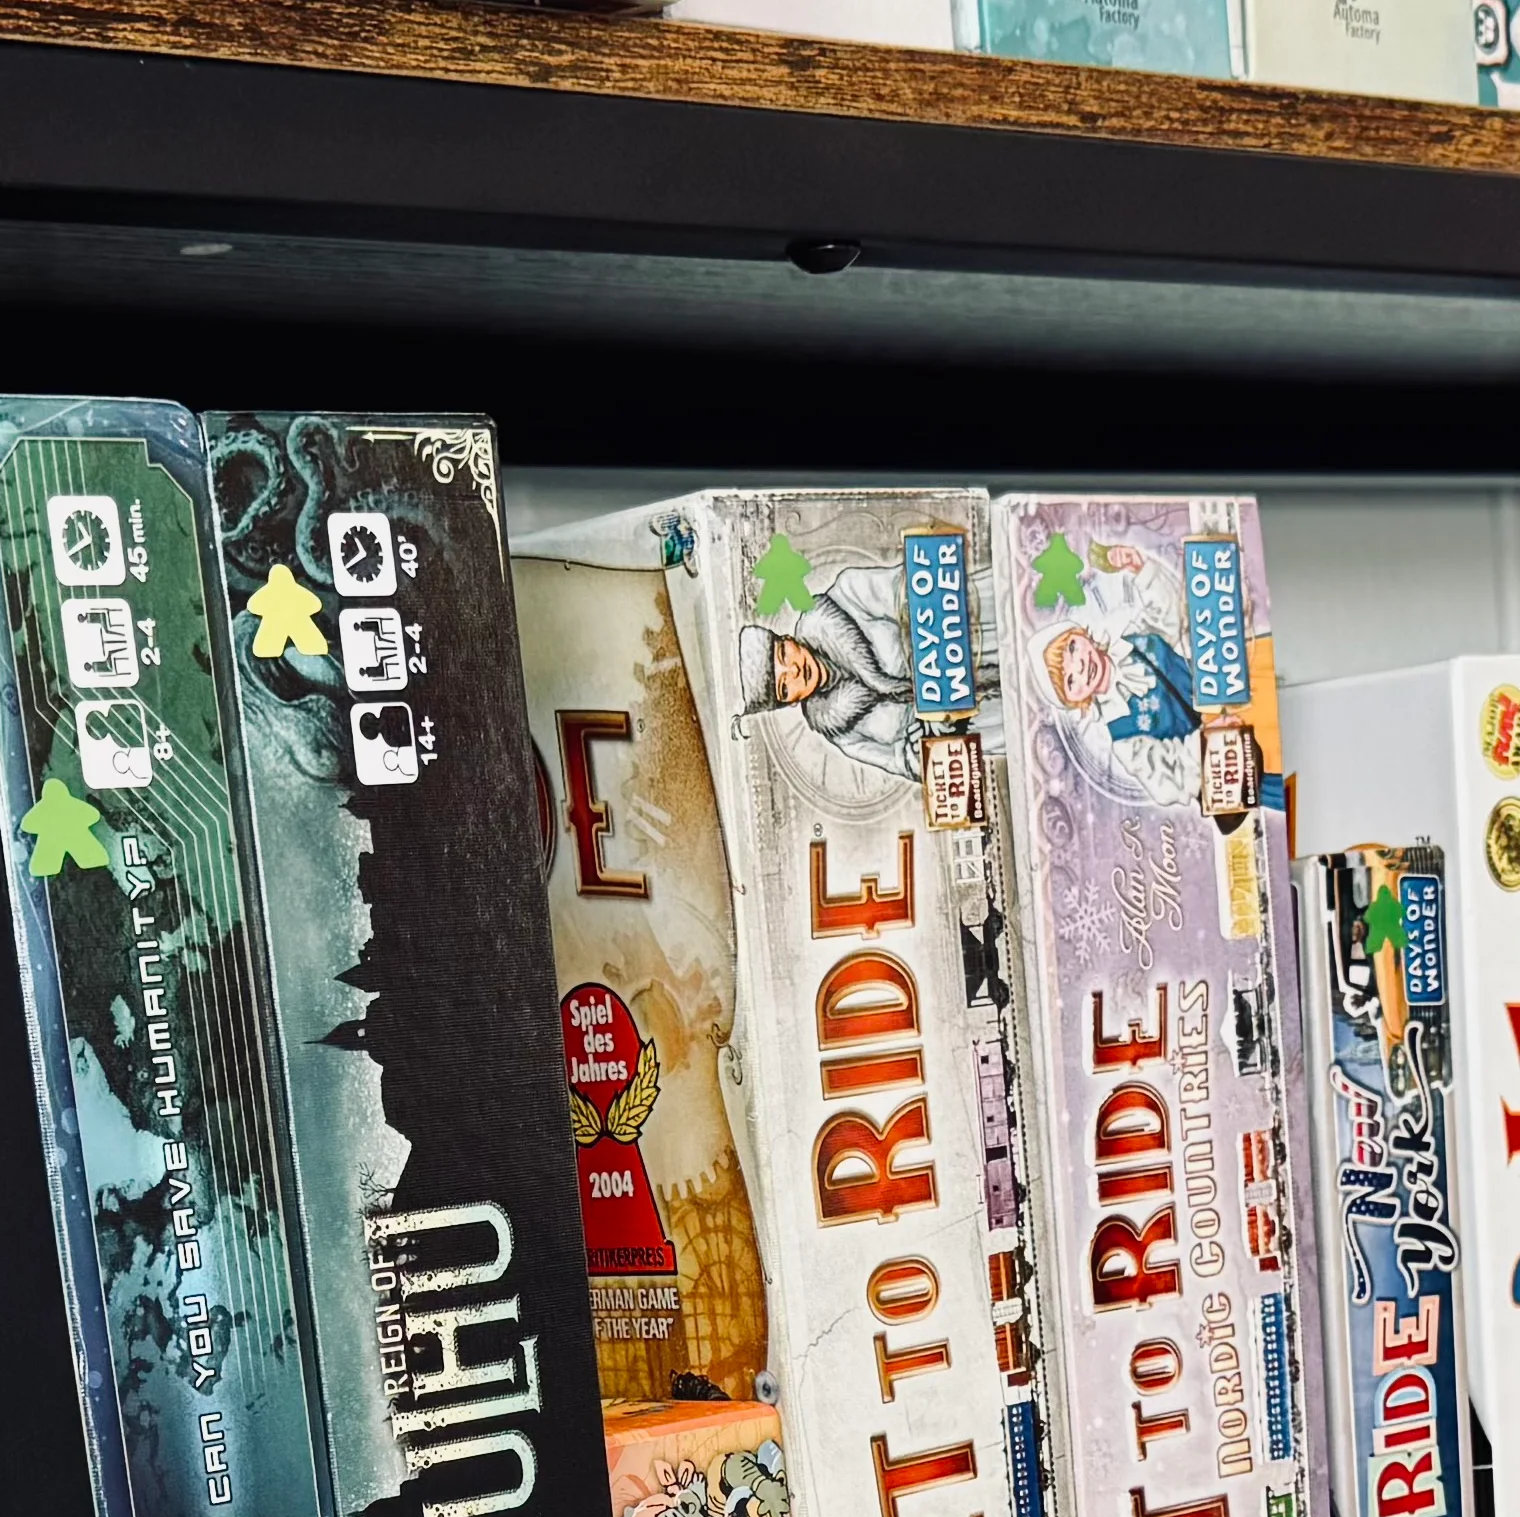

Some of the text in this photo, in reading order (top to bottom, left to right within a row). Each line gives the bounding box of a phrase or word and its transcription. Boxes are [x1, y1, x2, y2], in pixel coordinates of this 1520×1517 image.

[1099, 8, 1140, 31] Factory
[1334, 7, 1380, 25] Automa
[127, 548, 149, 583] 45
[140, 618, 162, 665] 2-4
[409, 623, 428, 674] 2-4
[911, 545, 941, 702] DAYS OF
[938, 544, 970, 701] WONDER
[1191, 550, 1218, 696] DAYS OF
[1214, 550, 1246, 696] WONDER
[154, 726, 174, 760] 8+
[420, 716, 439, 764] 14+
[949, 743, 965, 798] RIDE
[1150, 823, 1184, 931] Moon
[1406, 889, 1423, 993] DAYS OF
[1421, 885, 1440, 992] WONDER
[570, 995, 614, 1028] Spiel
[583, 1027, 614, 1054] des
[809, 829, 940, 1227] RIDE
[570, 1055, 628, 1084] Jahres
[122, 836, 231, 1504] CAN YOU SAVE HUMANITY?
[1089, 983, 1182, 1314] RIDE
[1178, 980, 1225, 1277] COUNTRIES
[1394, 1021, 1461, 1298] York
[589, 1171, 634, 1198] 2004
[1330, 1064, 1398, 1305] New
[370, 1254, 410, 1397] REIGN OF
[637, 1288, 680, 1310] GAME
[866, 1255, 951, 1403] TO
[1128, 1336, 1190, 1462] TO
